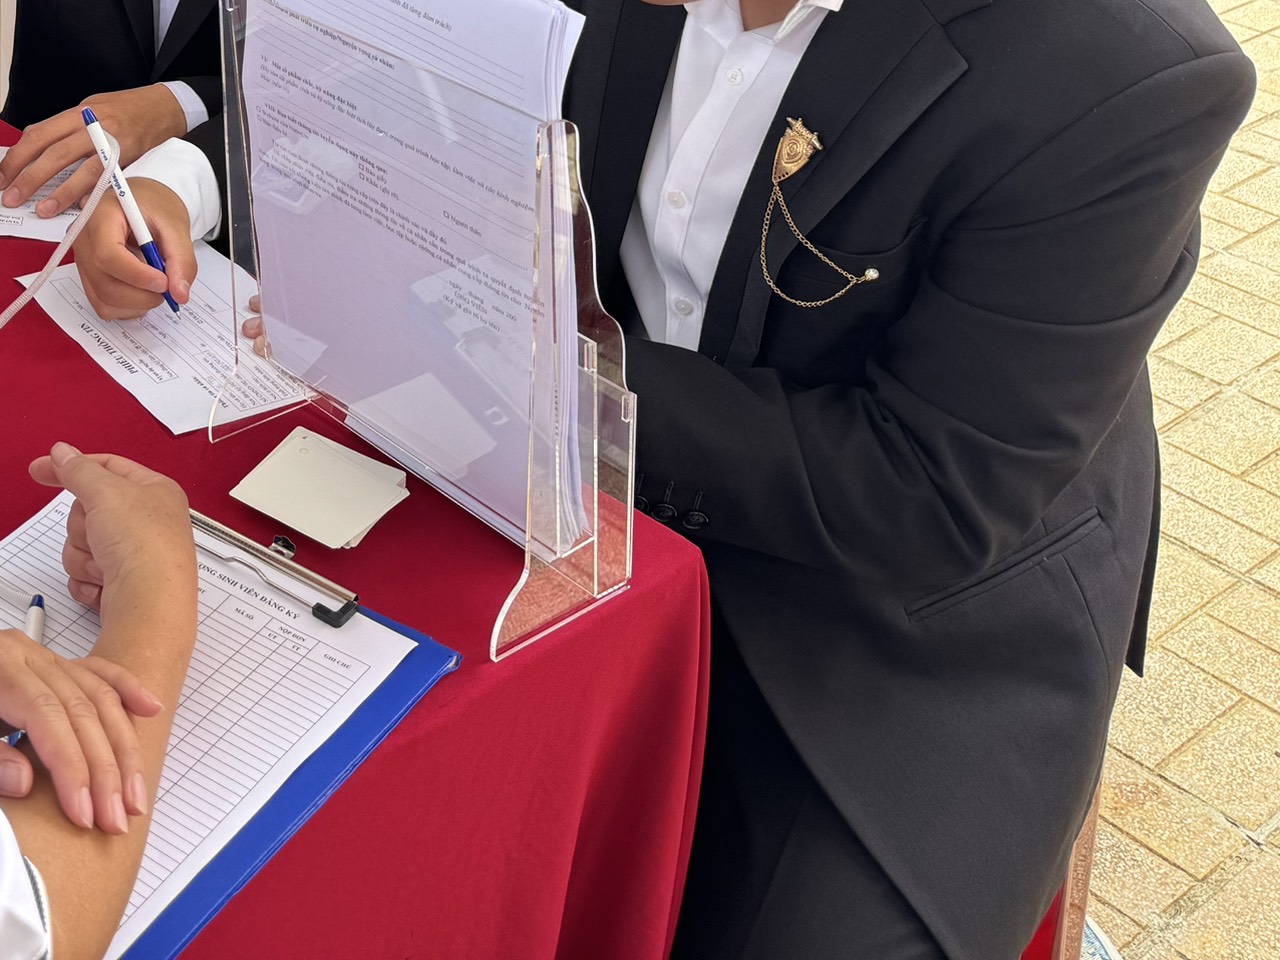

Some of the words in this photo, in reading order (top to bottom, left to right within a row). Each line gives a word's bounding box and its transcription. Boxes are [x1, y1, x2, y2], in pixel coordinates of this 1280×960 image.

[198, 560, 218, 577] ỢNG
[217, 573, 239, 588] SINH
[239, 583, 259, 600] VIÊN
[260, 594, 286, 613] ĐĂNG
[323, 653, 337, 663] GHI
